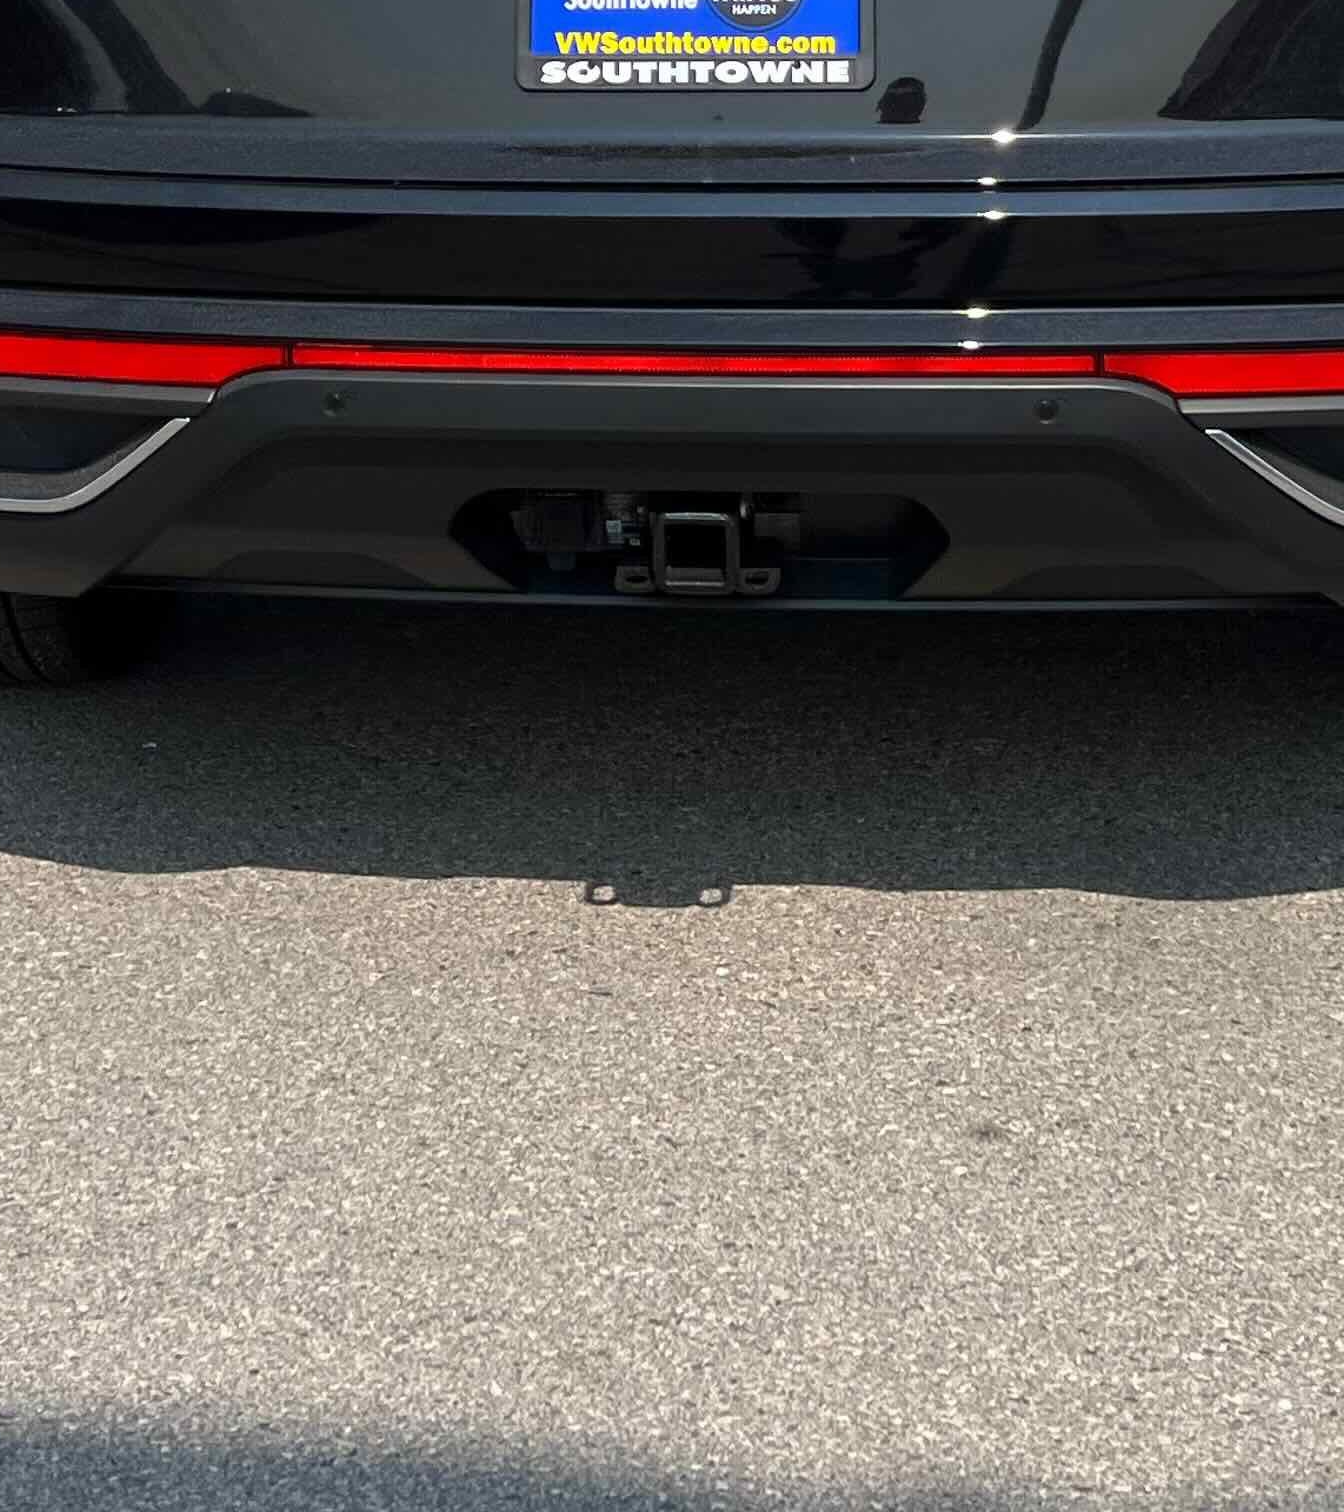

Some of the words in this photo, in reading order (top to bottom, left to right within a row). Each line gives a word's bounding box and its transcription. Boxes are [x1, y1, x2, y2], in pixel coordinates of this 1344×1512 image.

[732, 4, 777, 15] HAPPEN
[555, 32, 836, 55] VWSouthtowne.com
[540, 61, 850, 84] SOUTHTOWNE
